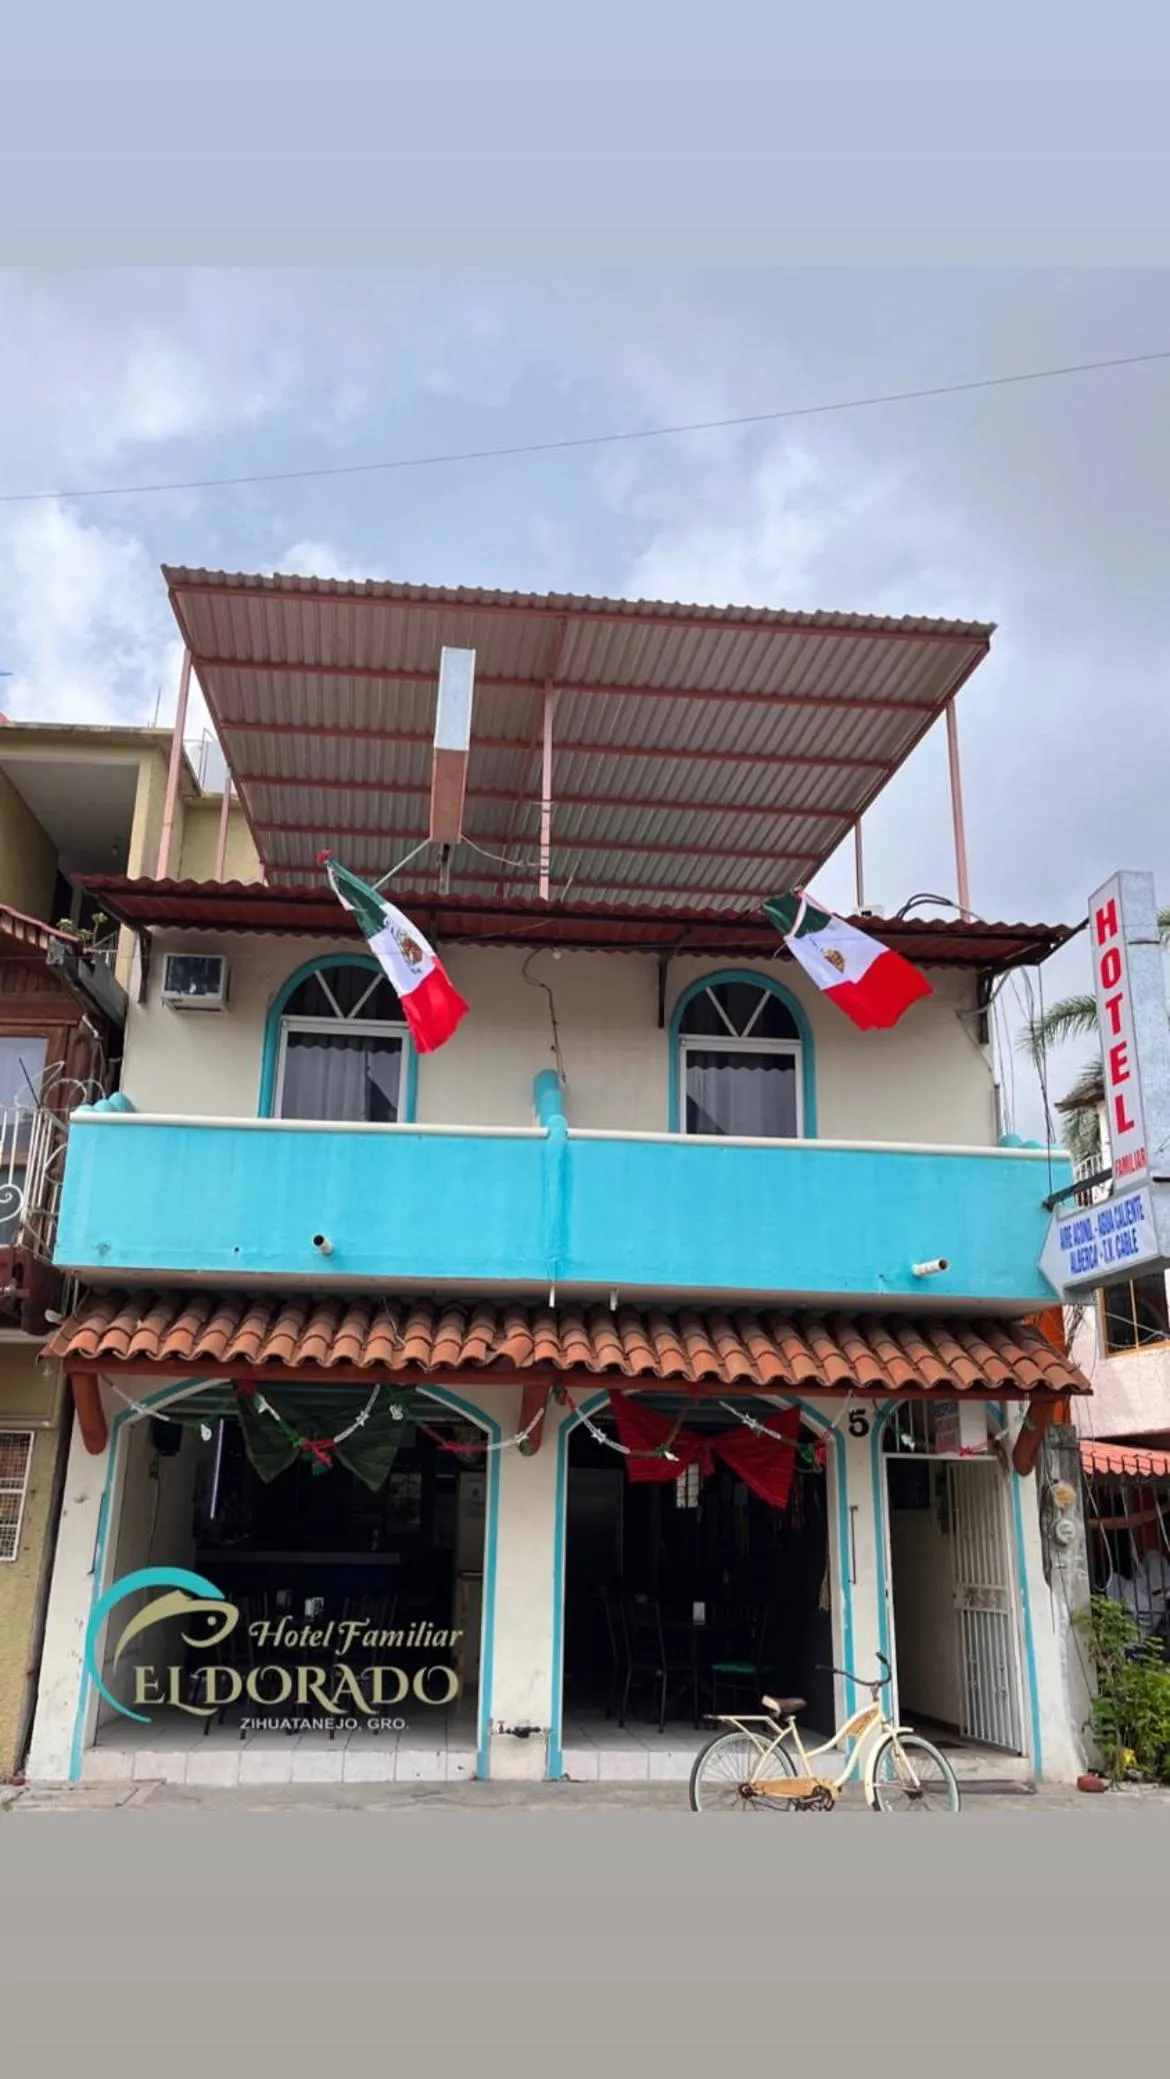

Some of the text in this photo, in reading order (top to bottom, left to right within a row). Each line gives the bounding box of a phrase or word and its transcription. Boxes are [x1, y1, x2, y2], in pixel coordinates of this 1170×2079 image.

[1095, 897, 1135, 1136] HOTEL
[1115, 1146, 1147, 1180] FAMILIAR
[1114, 1194, 1145, 1230] CALIENTE
[1070, 1243, 1098, 1275] ALBERCA
[1115, 1227, 1139, 1259] CABLE
[849, 1409, 869, 1437] 5
